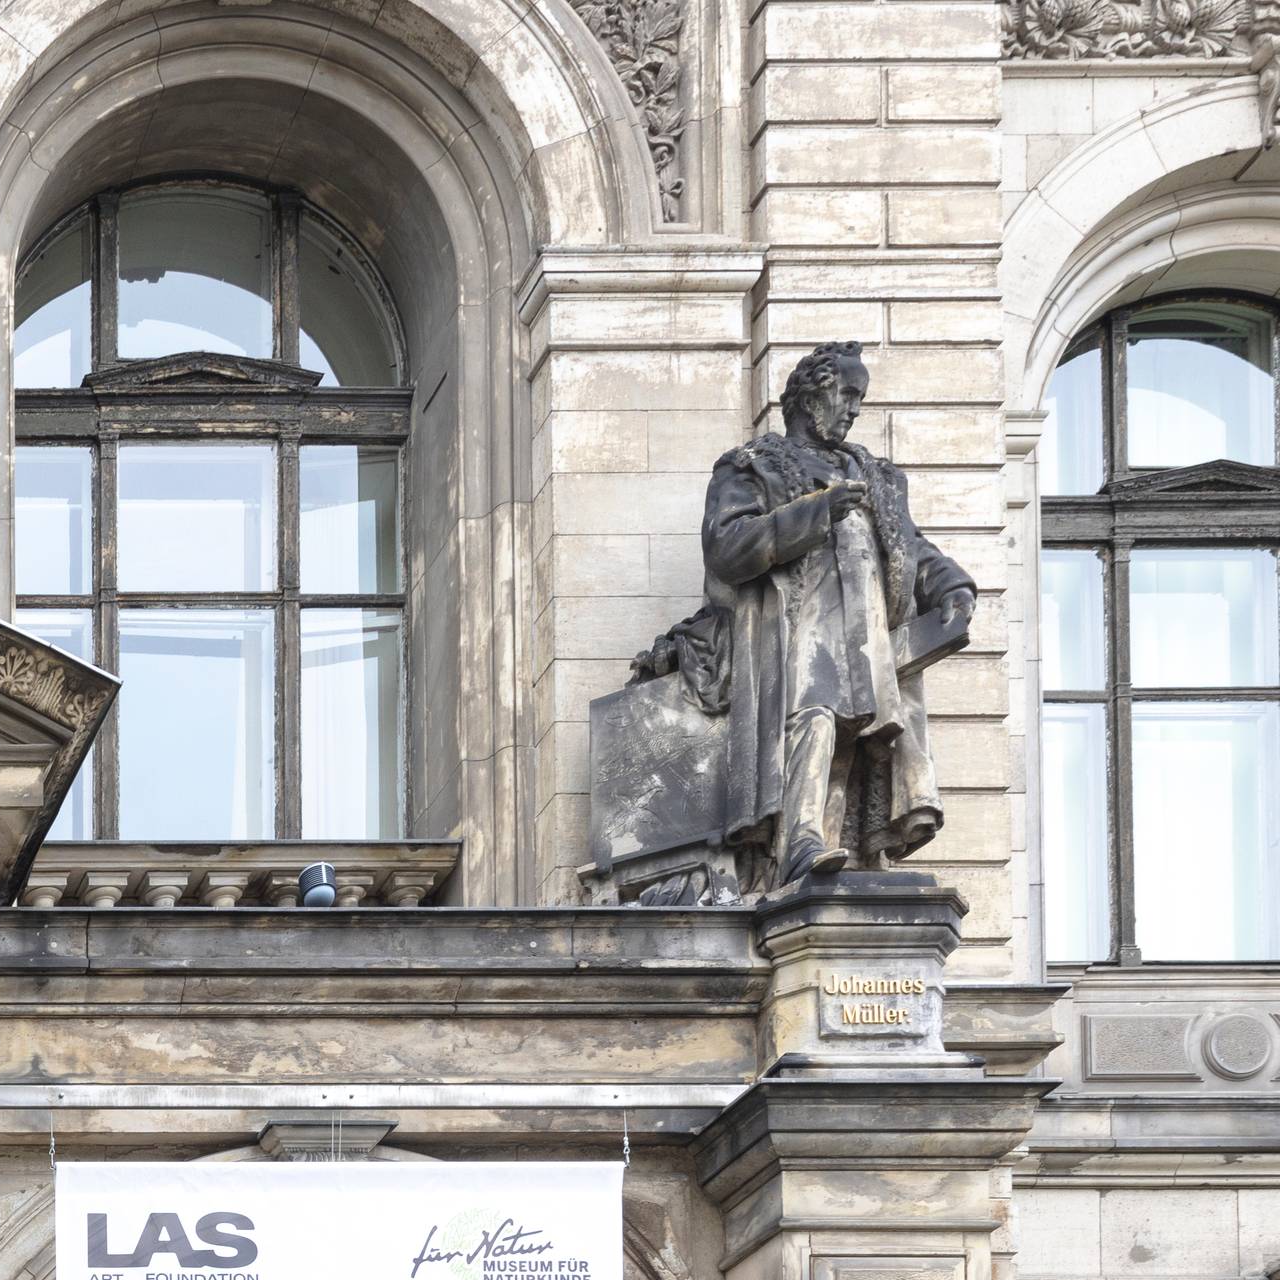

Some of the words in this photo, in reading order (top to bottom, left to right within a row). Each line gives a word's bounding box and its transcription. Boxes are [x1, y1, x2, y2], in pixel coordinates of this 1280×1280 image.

[824, 974, 925, 994] Johannes
[87, 1211, 258, 1268] LAS
[411, 1225, 463, 1278] für
[466, 1218, 554, 1264] Natur
[483, 1261, 553, 1272] MUSEUM
[558, 1258, 589, 1272] FÜR
